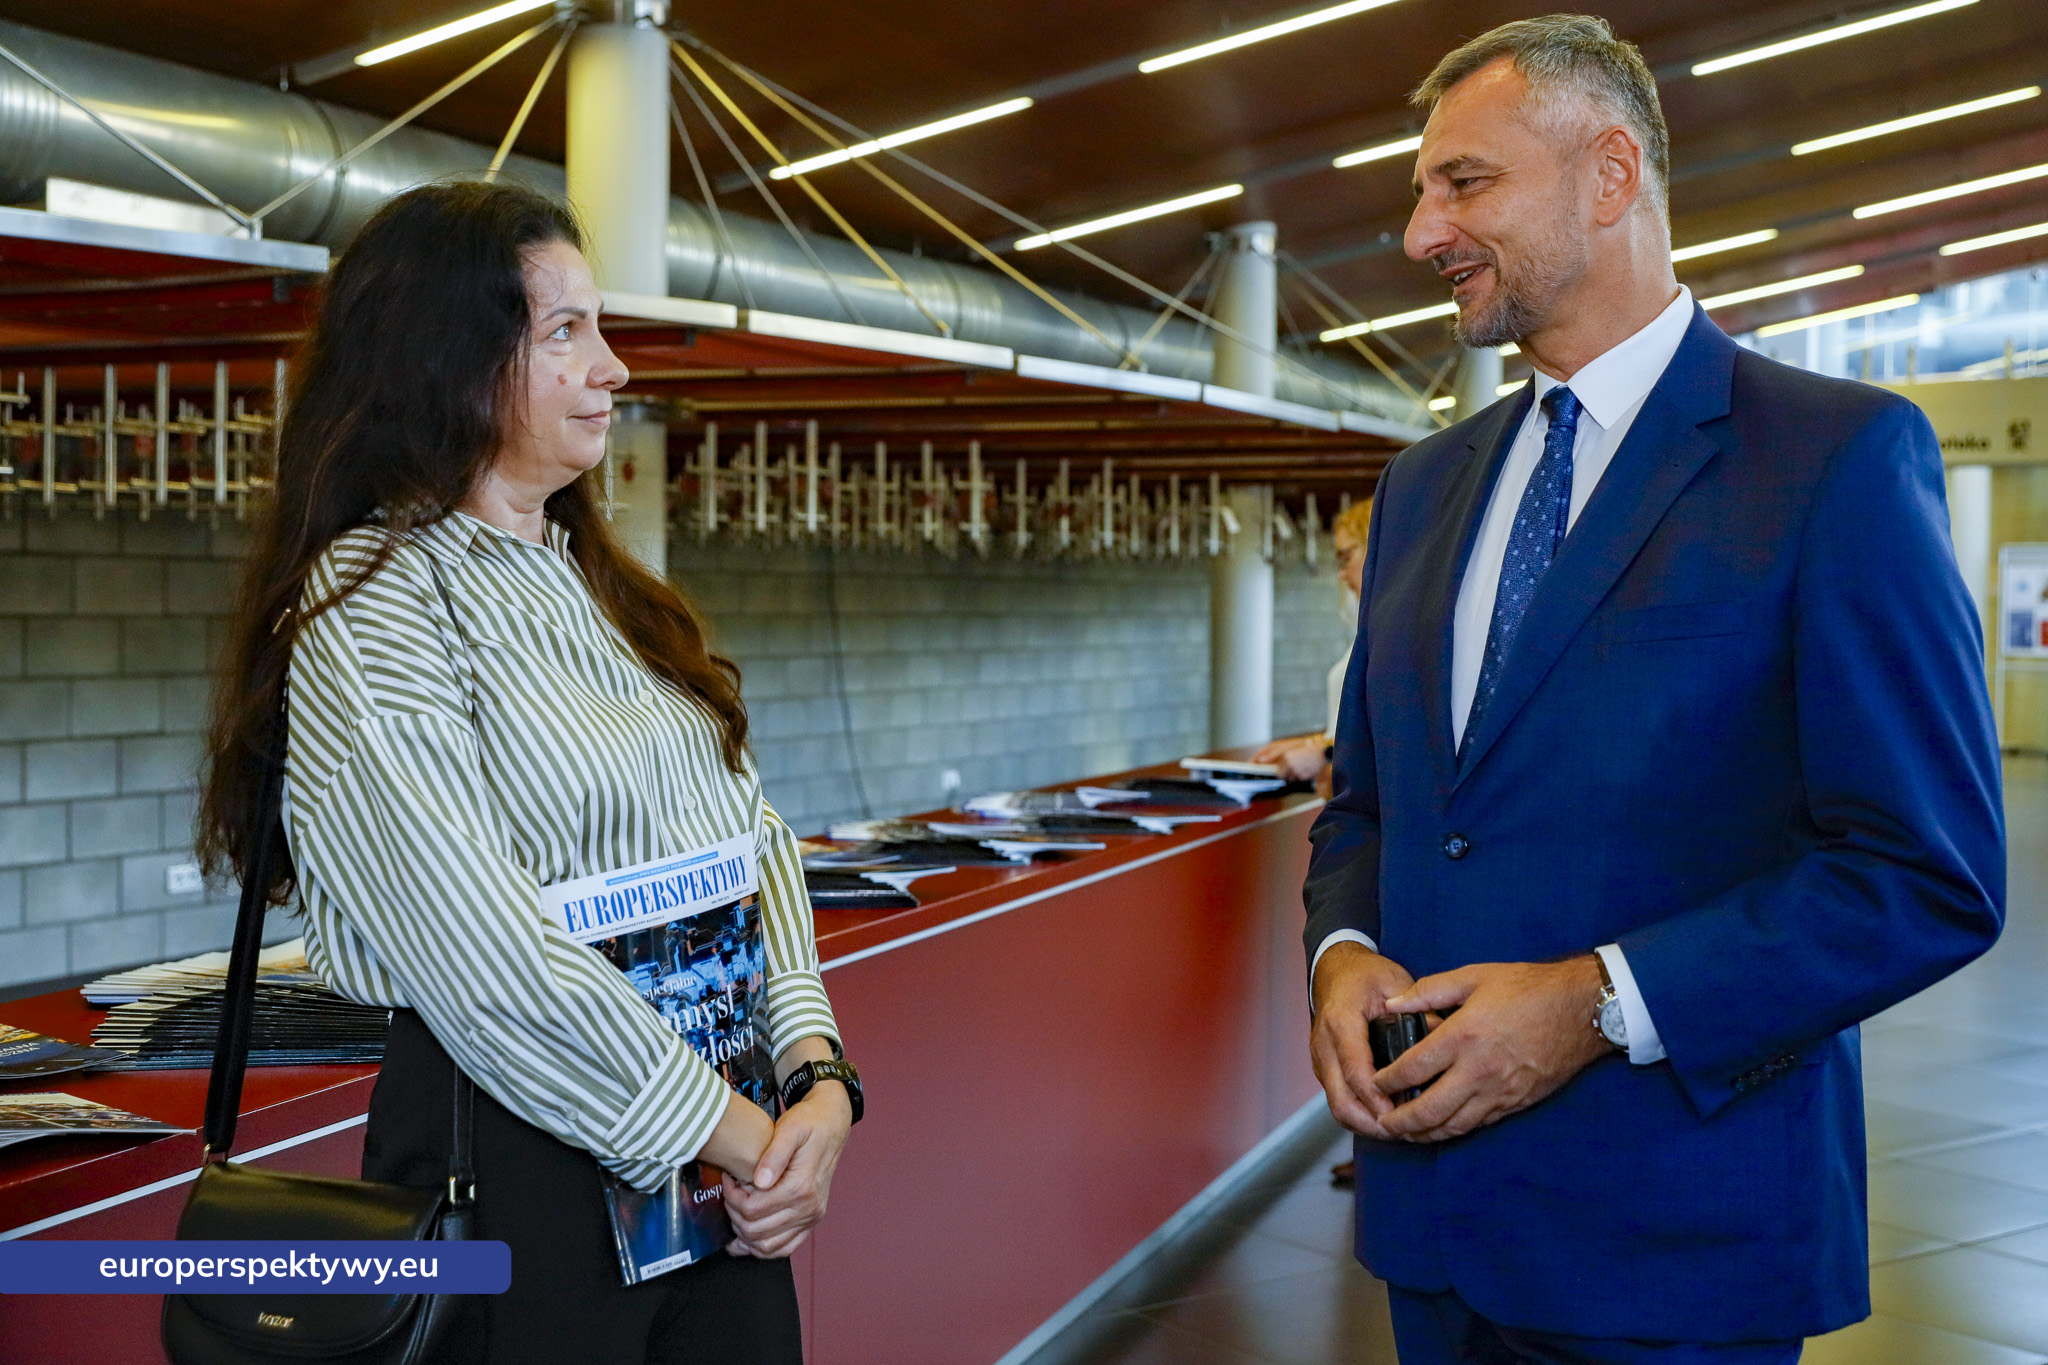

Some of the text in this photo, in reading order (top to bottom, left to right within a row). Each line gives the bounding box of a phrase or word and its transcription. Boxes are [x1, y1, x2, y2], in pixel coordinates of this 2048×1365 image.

[563, 854, 747, 933] EUROPERSPEKTYWY
[642, 976, 696, 1001] specjalne
[693, 1183, 722, 1204] Gosp
